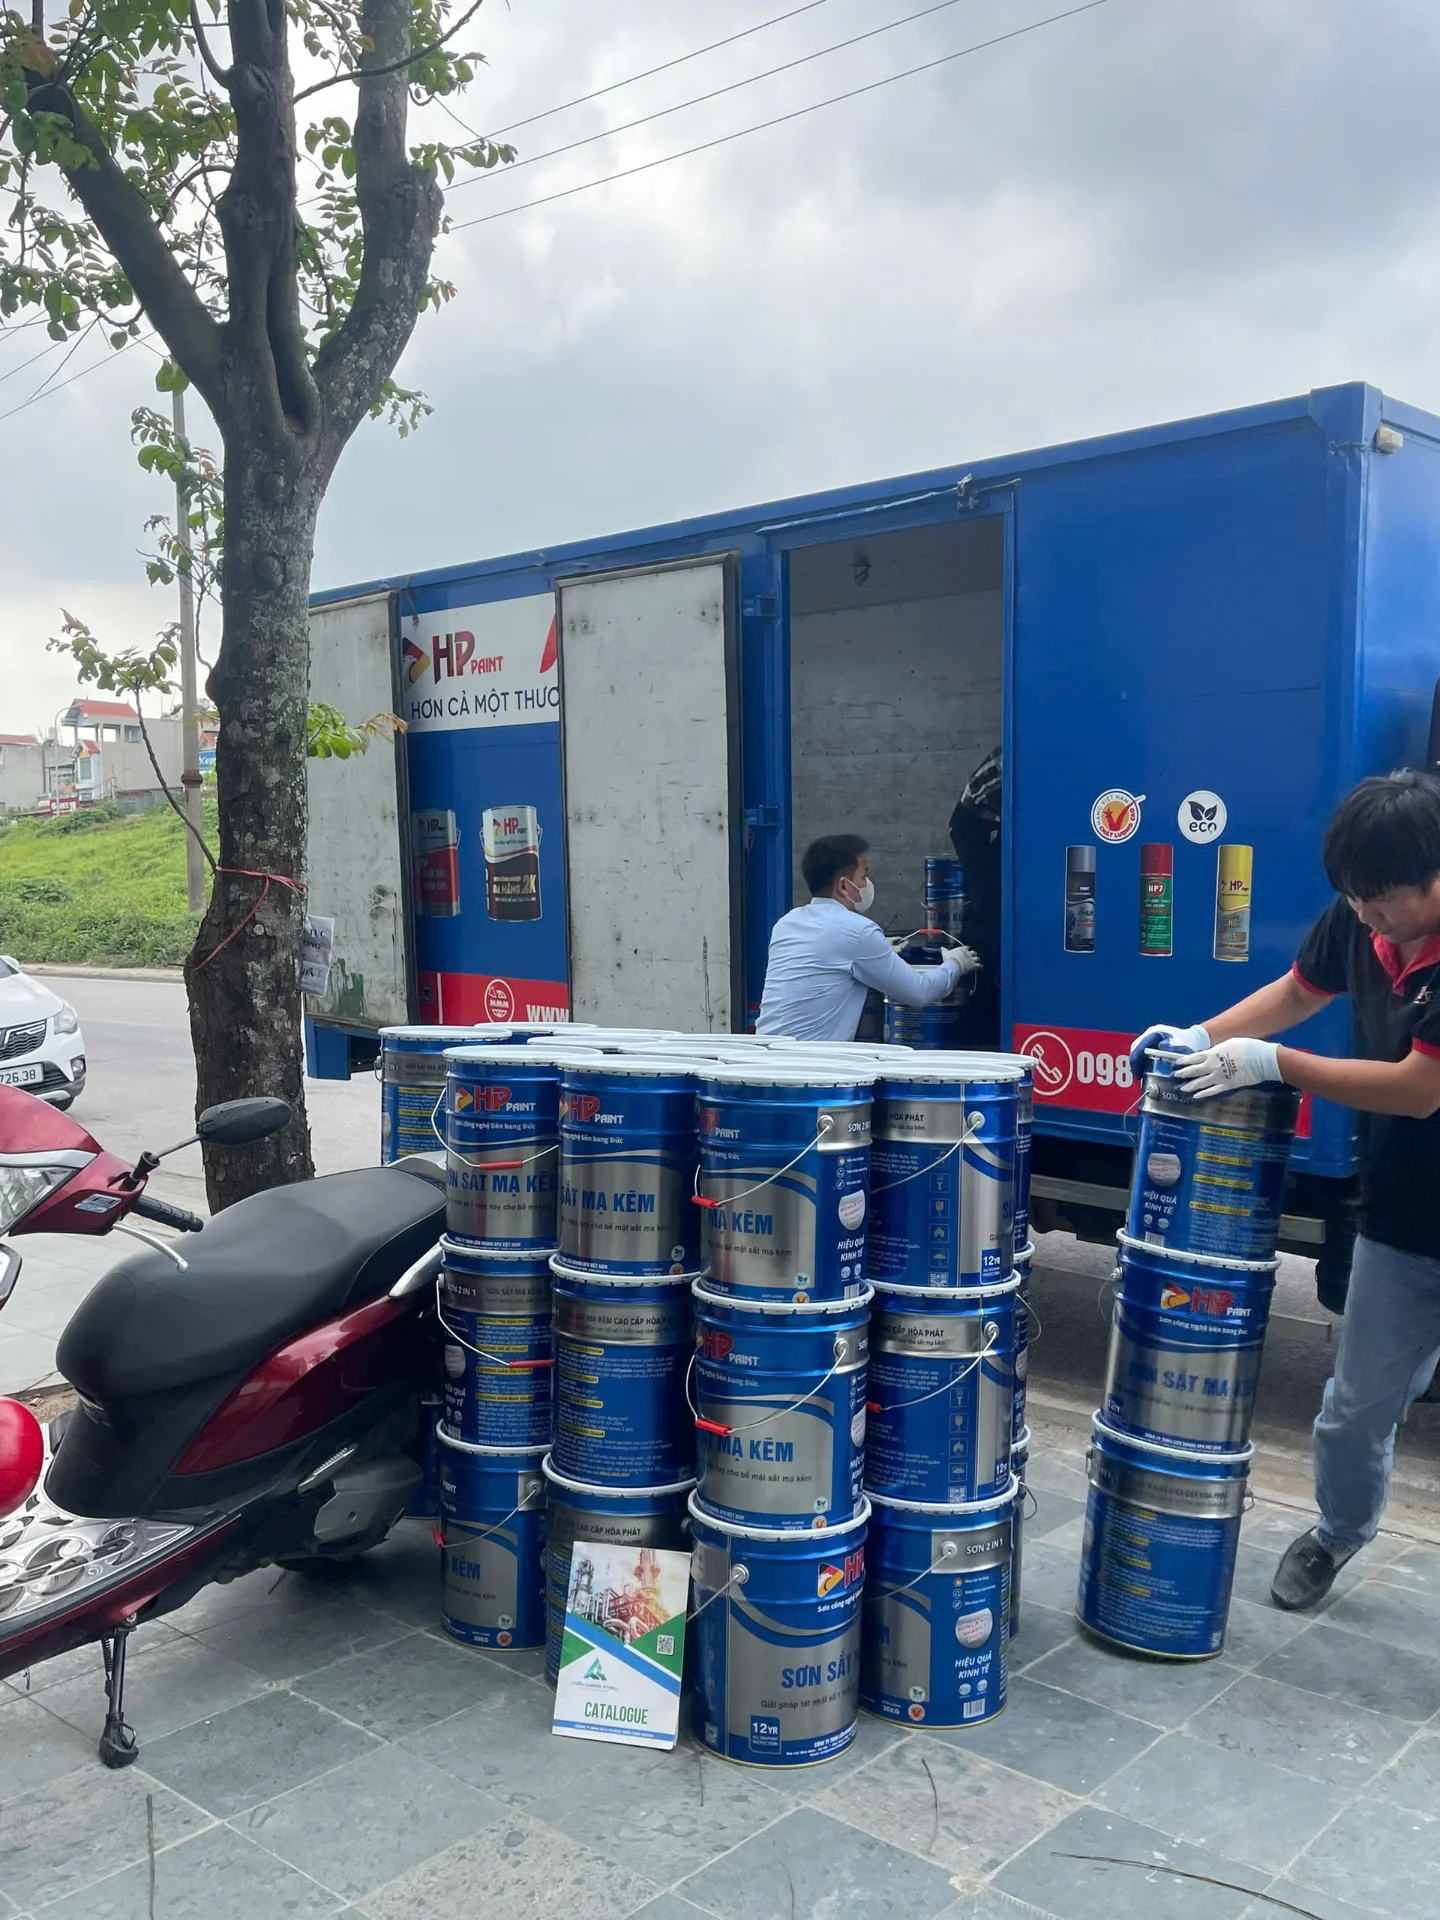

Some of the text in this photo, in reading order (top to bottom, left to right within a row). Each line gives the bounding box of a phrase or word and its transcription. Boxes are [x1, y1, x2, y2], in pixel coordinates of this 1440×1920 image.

[433, 630, 504, 684] HP PAINT
[411, 698, 443, 720] HƠN
[447, 690, 470, 716] CẢ
[474, 688, 510, 718] MỘT
[503, 817, 519, 837] HP
[1189, 821, 1217, 834] eco
[1148, 884, 1164, 892] HP7
[474, 1085, 536, 1113] HP PAINT
[569, 1093, 624, 1124] HP PAINT
[905, 1112, 925, 1122] PHÁT
[504, 1122, 521, 1131] bang
[522, 1122, 536, 1130] Đức
[715, 1127, 740, 1139] PAINT
[847, 1122, 861, 1133] SƠN
[593, 1134, 609, 1145] bang
[609, 1134, 624, 1144] Đức
[461, 1168, 520, 1197] SẮT MẠ
[581, 1189, 608, 1215] MẠ
[613, 1189, 655, 1213] KẼM
[1160, 1194, 1177, 1205] QUẢ
[503, 1203, 516, 1211] cho
[630, 1223, 642, 1232] sắt
[708, 1208, 773, 1235] MẠ KẼM
[748, 1246, 760, 1255] sắt
[458, 1286, 462, 1294] 2
[462, 1287, 471, 1296] IN
[472, 1289, 476, 1297] 1
[1191, 1286, 1252, 1317] HP PAINT
[613, 1317, 629, 1325] CAO
[630, 1315, 645, 1325] CẤP
[645, 1315, 661, 1325] HÒA
[892, 1325, 945, 1338] CẤP HÒA PHÁT
[703, 1327, 760, 1366] HP PAINT
[727, 1375, 744, 1387] bang
[744, 1378, 759, 1387] Đức
[1163, 1366, 1198, 1394] SẮT
[718, 1434, 794, 1462] MẠ KẼM
[726, 1468, 739, 1477] cho
[751, 1474, 766, 1482] mặt
[768, 1473, 780, 1482] sắt
[590, 1524, 641, 1537] CẤP HÒA PHÁT
[966, 1537, 1003, 1555] SƠN 2 IN 1
[817, 1600, 845, 1613] Sơn công
[954, 1649, 992, 1669] HIỆU QUẢ
[781, 1650, 852, 1689] SƠN SẮT
[958, 1662, 991, 1679] KINH TẾ
[778, 1700, 799, 1710] pháp
[800, 1698, 811, 1708] tốt
[584, 1701, 649, 1725] CATALOGUE
[752, 1722, 778, 1735] 12YR
